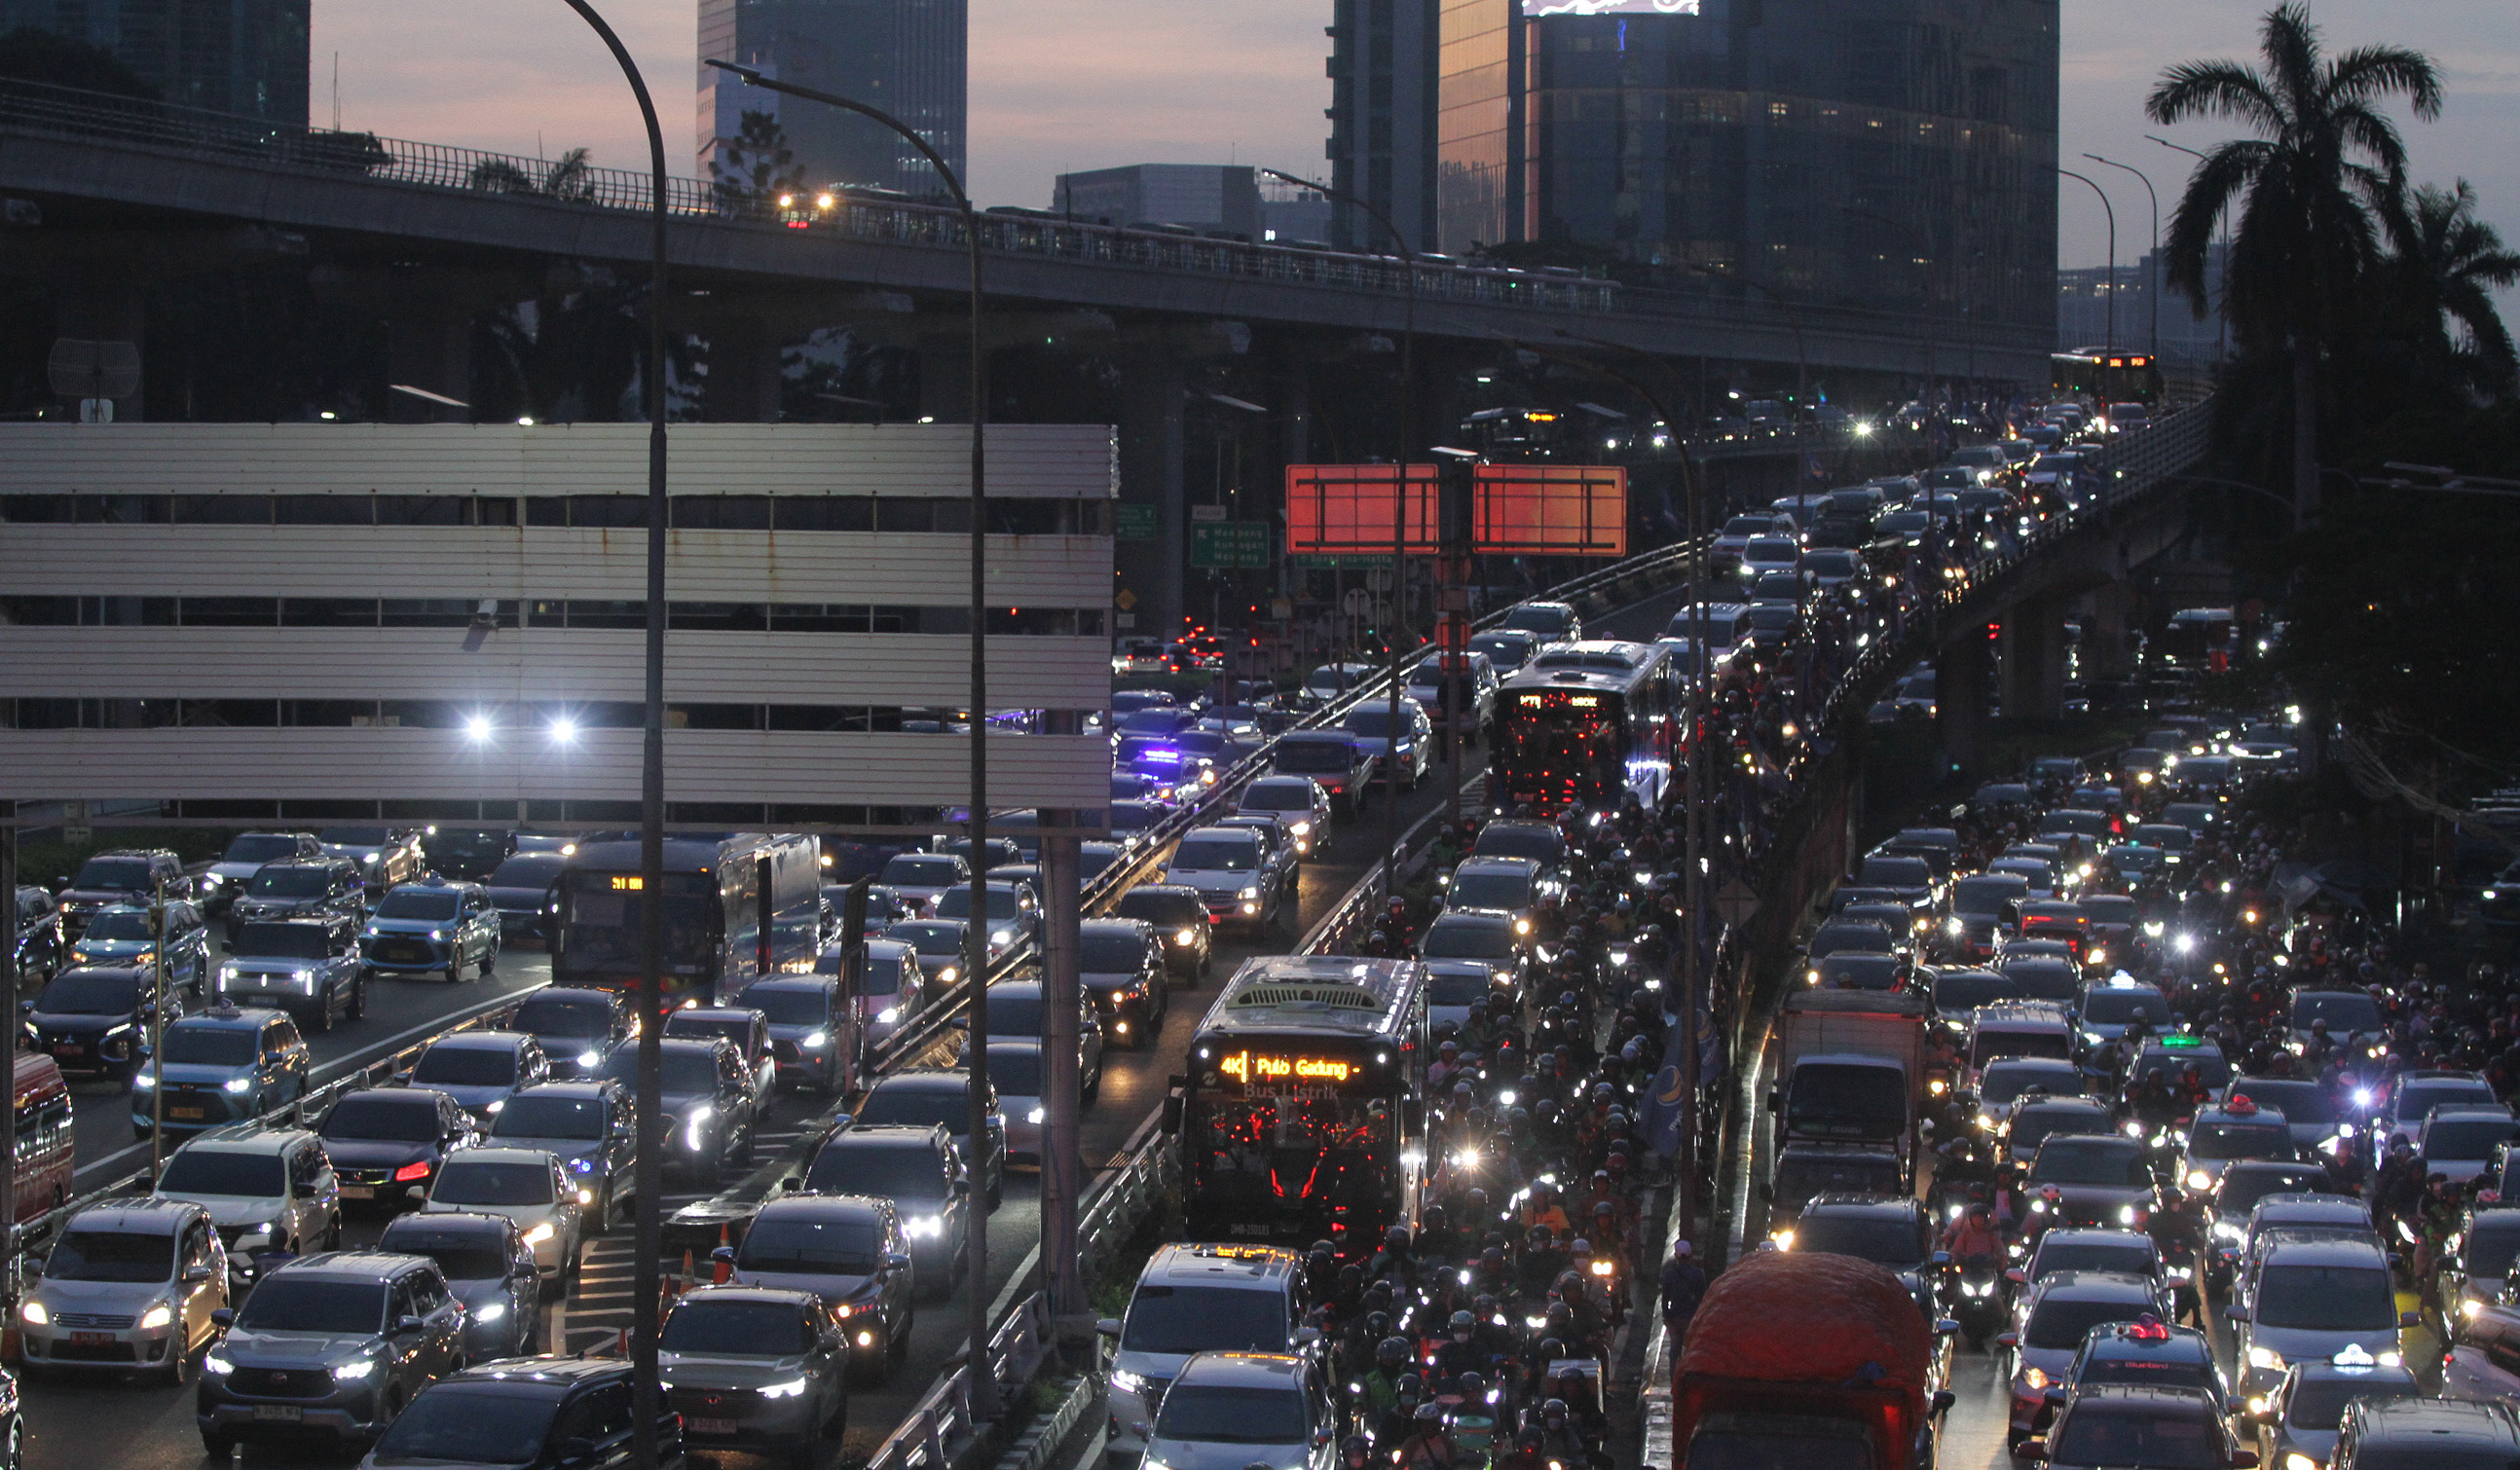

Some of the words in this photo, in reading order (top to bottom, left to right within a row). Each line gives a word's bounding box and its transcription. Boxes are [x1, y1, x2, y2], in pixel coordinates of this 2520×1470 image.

[1295, 1058, 1348, 1081] Gadung
[1243, 1082, 1277, 1099] Bus
[1282, 1083, 1339, 1100] Listrik
